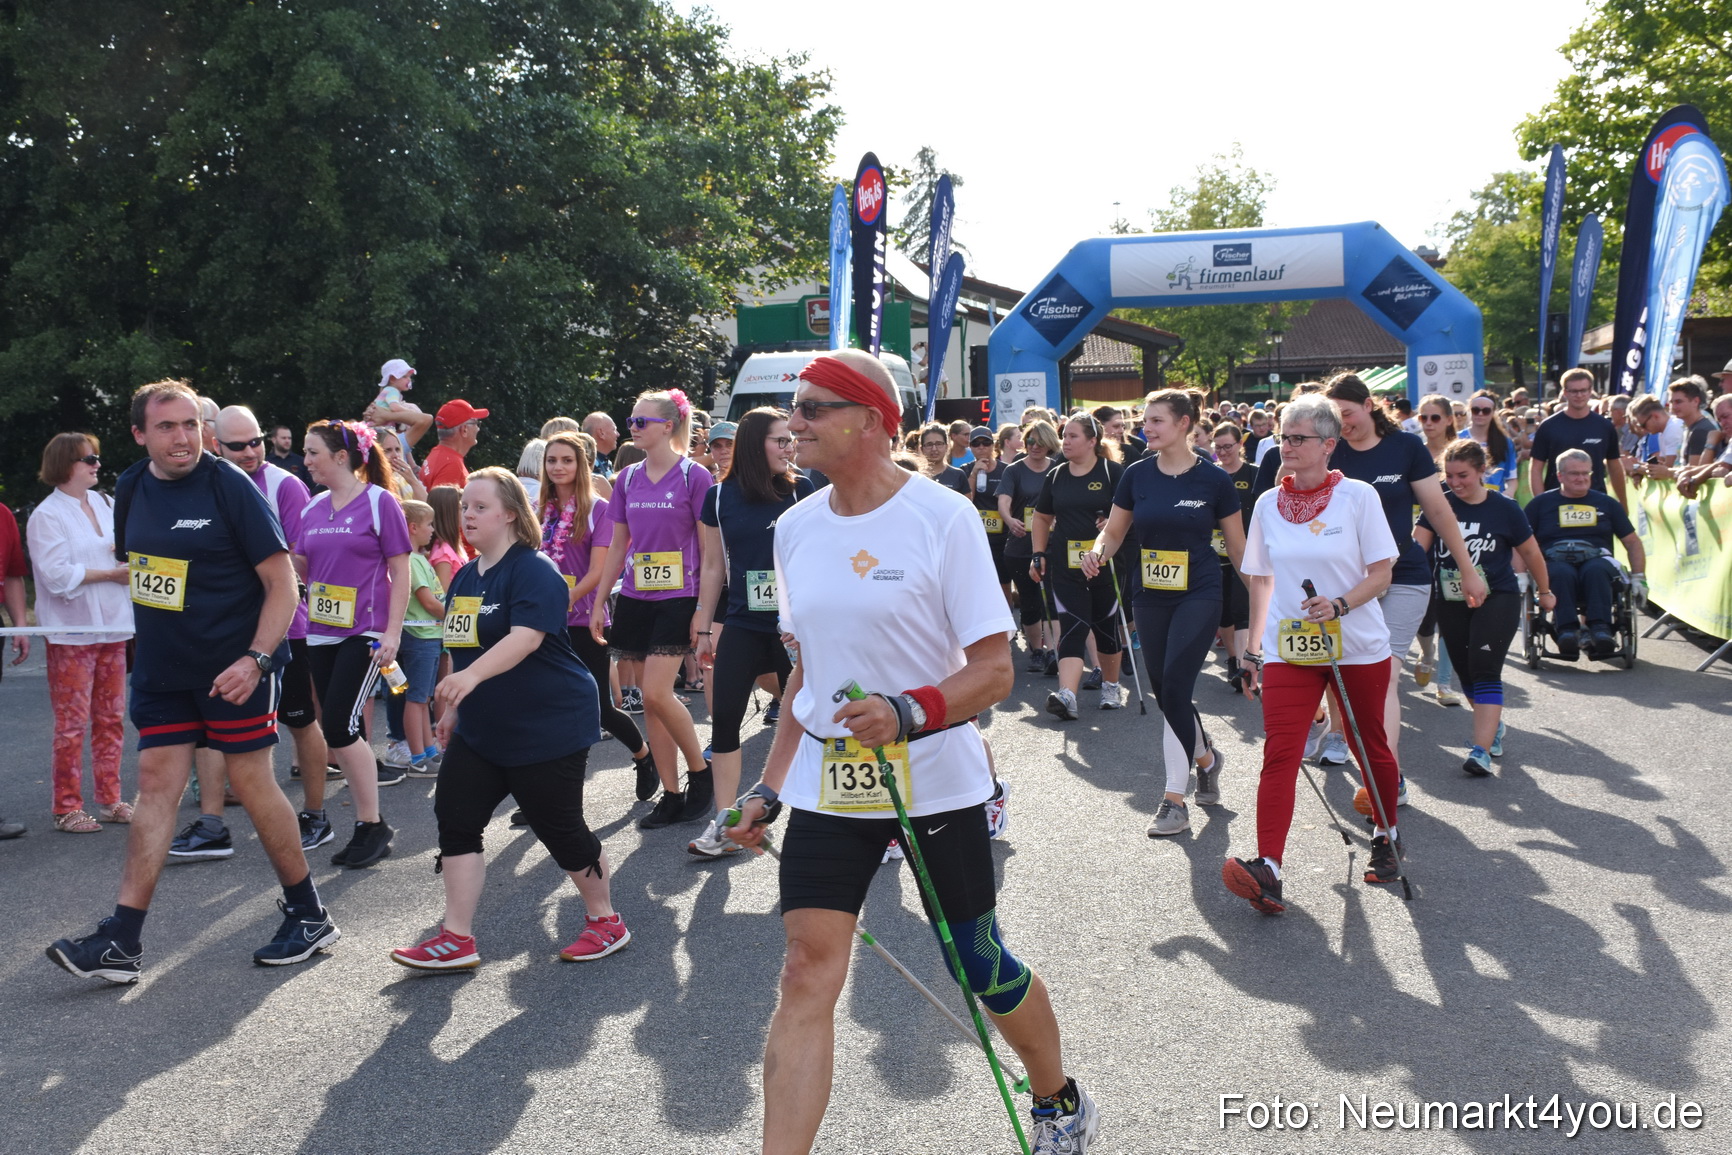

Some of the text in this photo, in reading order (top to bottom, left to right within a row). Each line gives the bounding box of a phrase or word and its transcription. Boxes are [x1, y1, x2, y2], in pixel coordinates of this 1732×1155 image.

[858, 179, 882, 212] Hervis
[1221, 251, 1250, 259] Fischer
[1200, 264, 1286, 284] firmenlauf
[1038, 304, 1083, 315] Fischer
[1565, 511, 1591, 520] 1429
[643, 565, 671, 580] 875
[1145, 563, 1181, 579] 1407
[134, 572, 176, 596] 1426
[317, 597, 340, 615] 891
[445, 614, 471, 633] 1450
[1286, 635, 1333, 652] 1359
